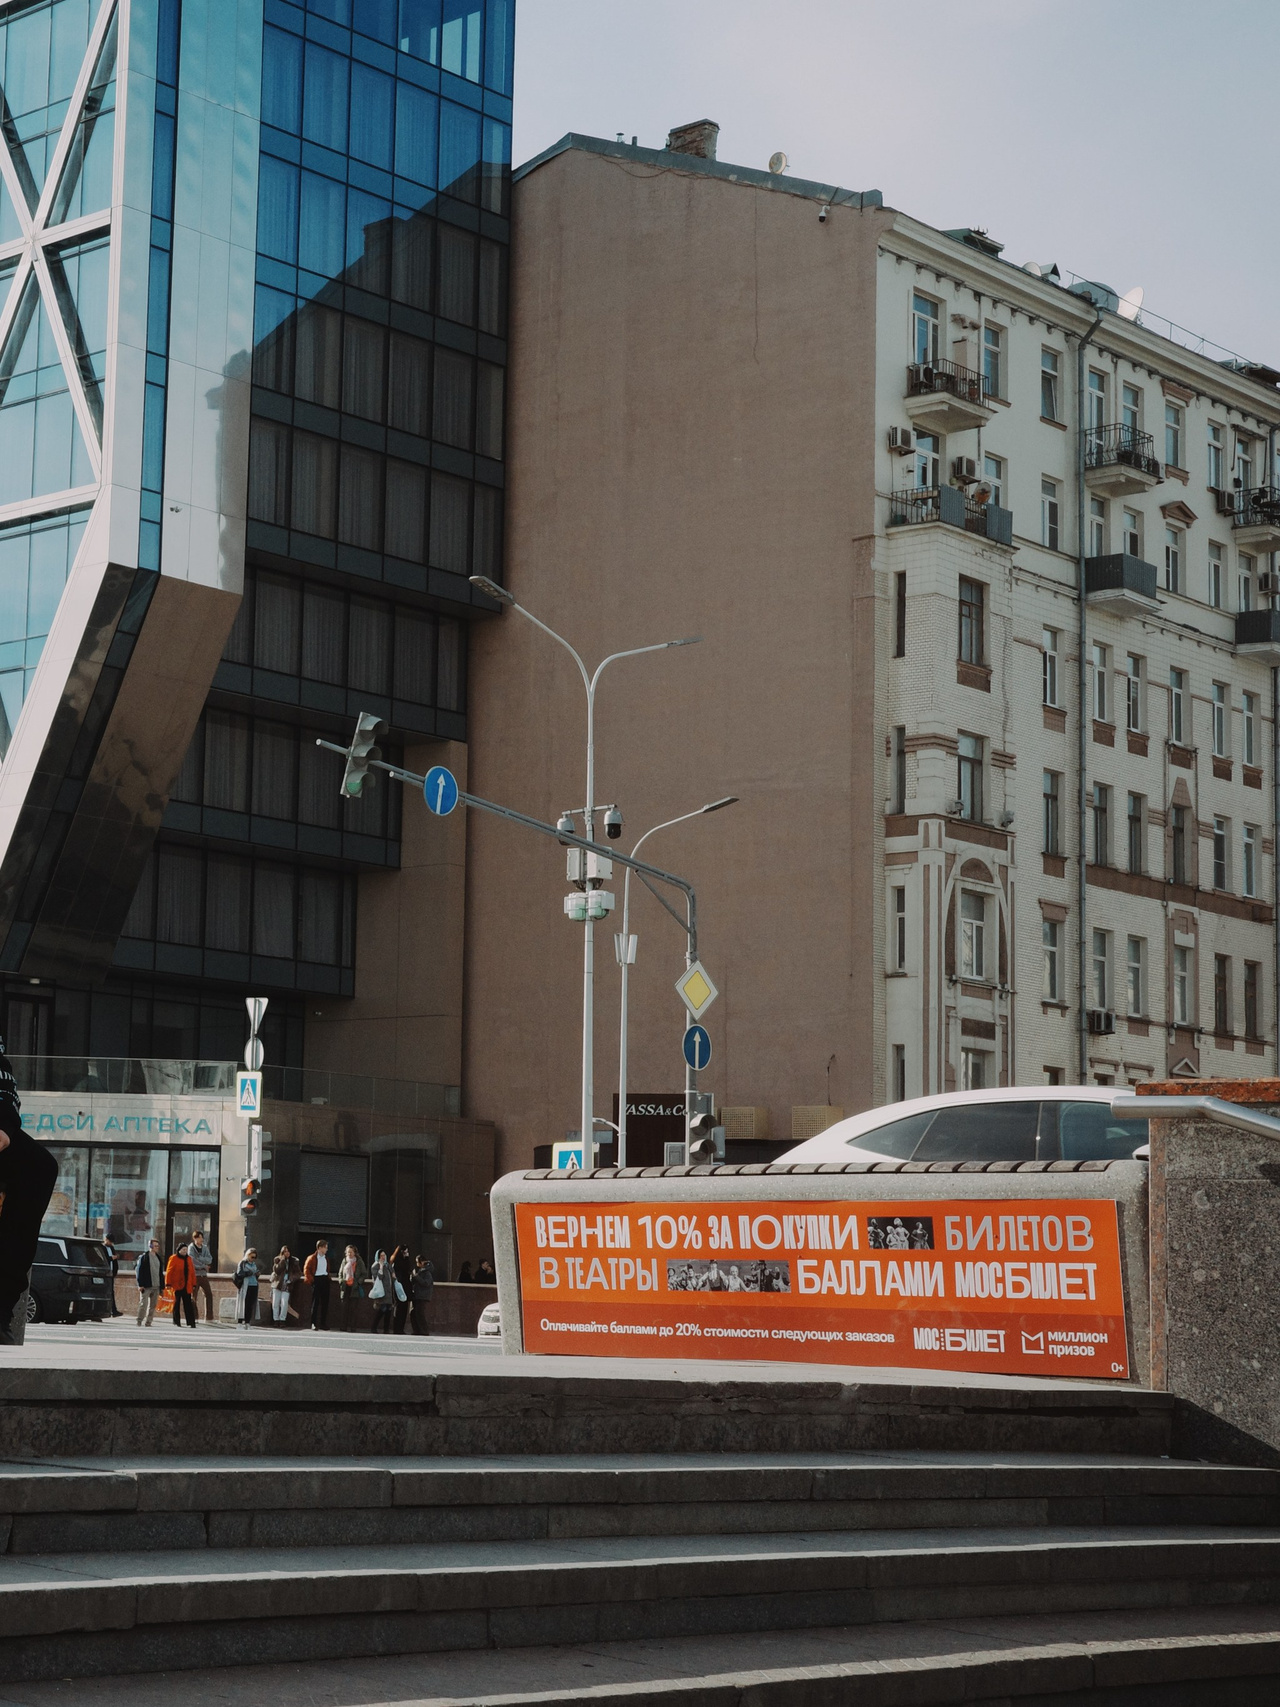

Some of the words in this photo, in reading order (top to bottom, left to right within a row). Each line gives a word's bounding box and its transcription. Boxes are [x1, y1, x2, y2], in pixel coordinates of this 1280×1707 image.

[21, 1113, 94, 1132] ЕДСИ
[104, 1116, 212, 1135] АПТЕКА
[535, 1215, 630, 1248] ВЕРНЕМ
[638, 1215, 702, 1249] 10%
[708, 1215, 733, 1249] ЗА
[738, 1215, 859, 1250] ПОКУПКИ
[944, 1215, 1094, 1251] БИЛЕТОВ
[539, 1257, 560, 1289] В
[565, 1257, 658, 1291] ТЕАТРЫ
[797, 1259, 945, 1298] БАЛЛАМИ
[954, 1261, 1097, 1300] МОСБИЛЕТ
[540, 1318, 608, 1333] Оплачивайте
[610, 1321, 657, 1335] баллами
[659, 1326, 673, 1337] до
[675, 1323, 701, 1336] 20%
[703, 1327, 769, 1338] стоимости
[771, 1329, 843, 1342] следующих
[845, 1331, 895, 1343] заказов
[1049, 1345, 1095, 1357] призов
[1111, 1362, 1124, 1373] 0+
